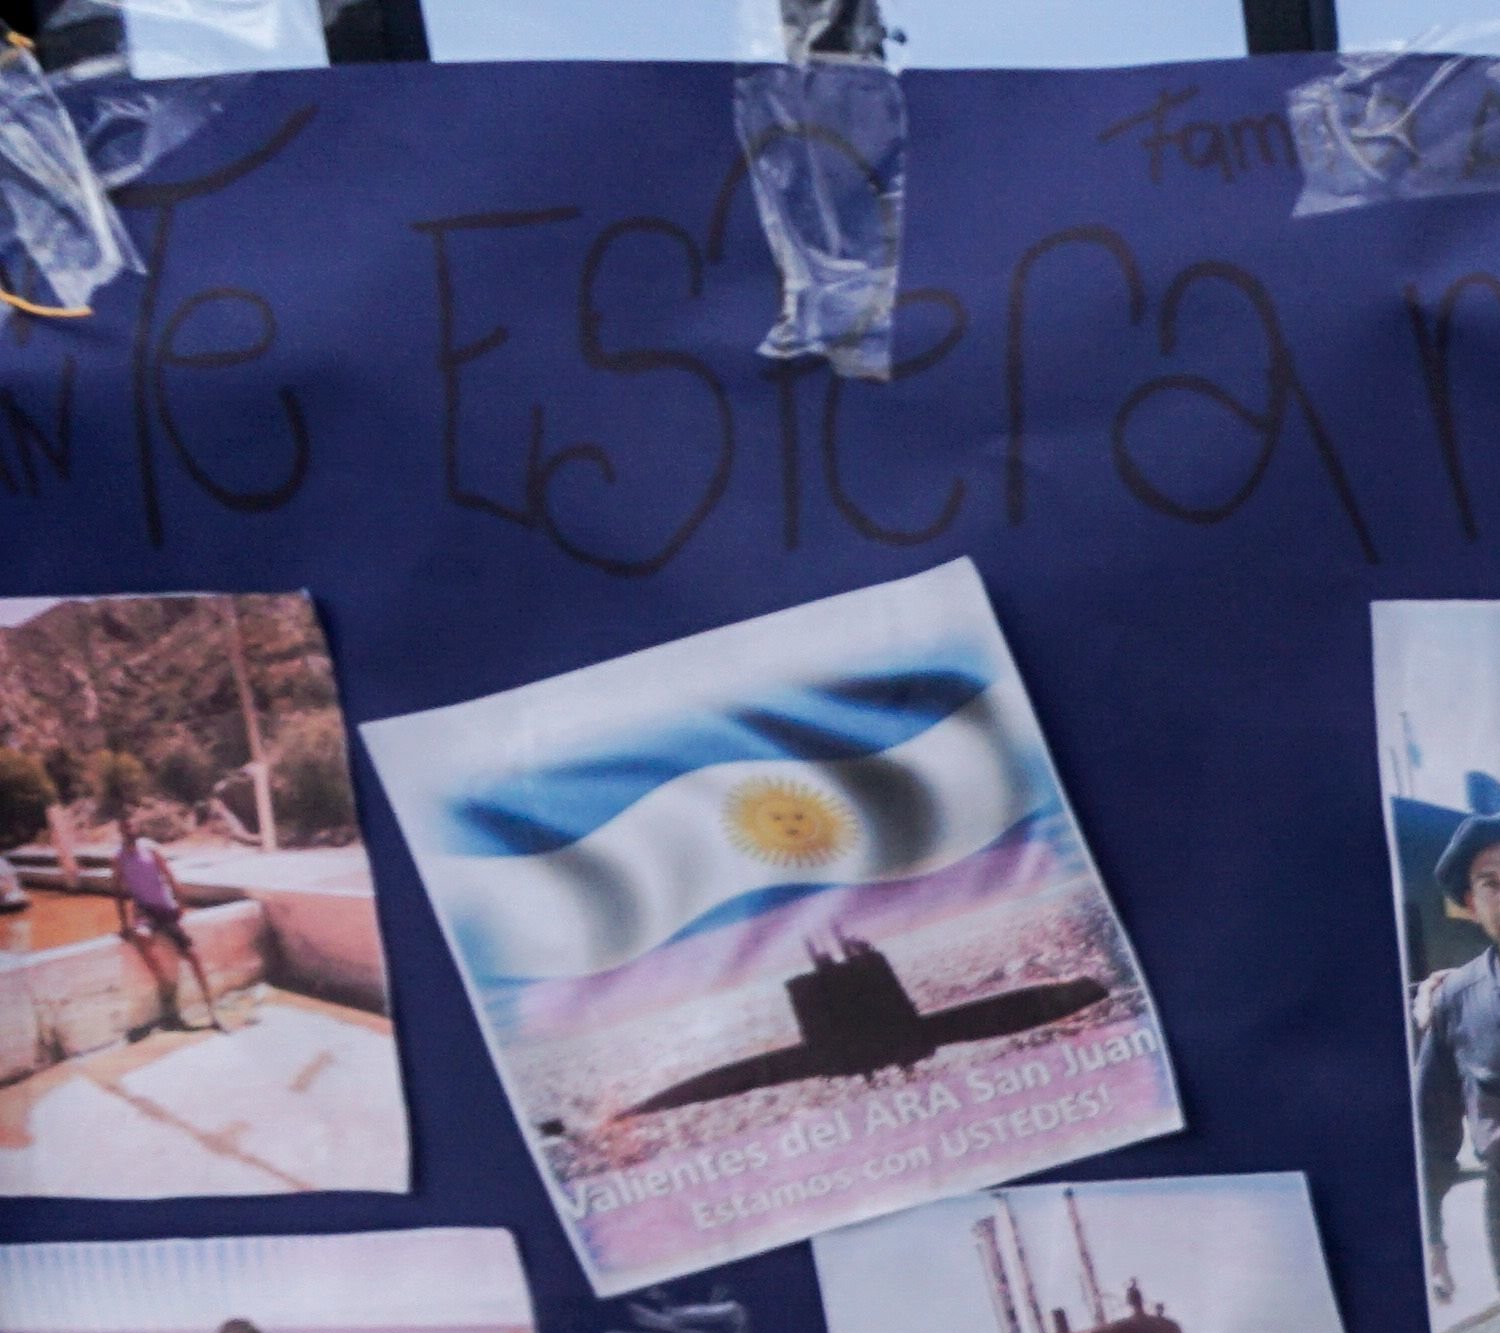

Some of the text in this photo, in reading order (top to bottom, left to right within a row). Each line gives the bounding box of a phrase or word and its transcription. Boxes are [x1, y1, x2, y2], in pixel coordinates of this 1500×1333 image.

[104, 103, 318, 549] Te
[566, 1029, 1160, 1222] Valientes del ARA San Juan
[693, 1085, 1112, 1232] Estamos con USTEDES!
